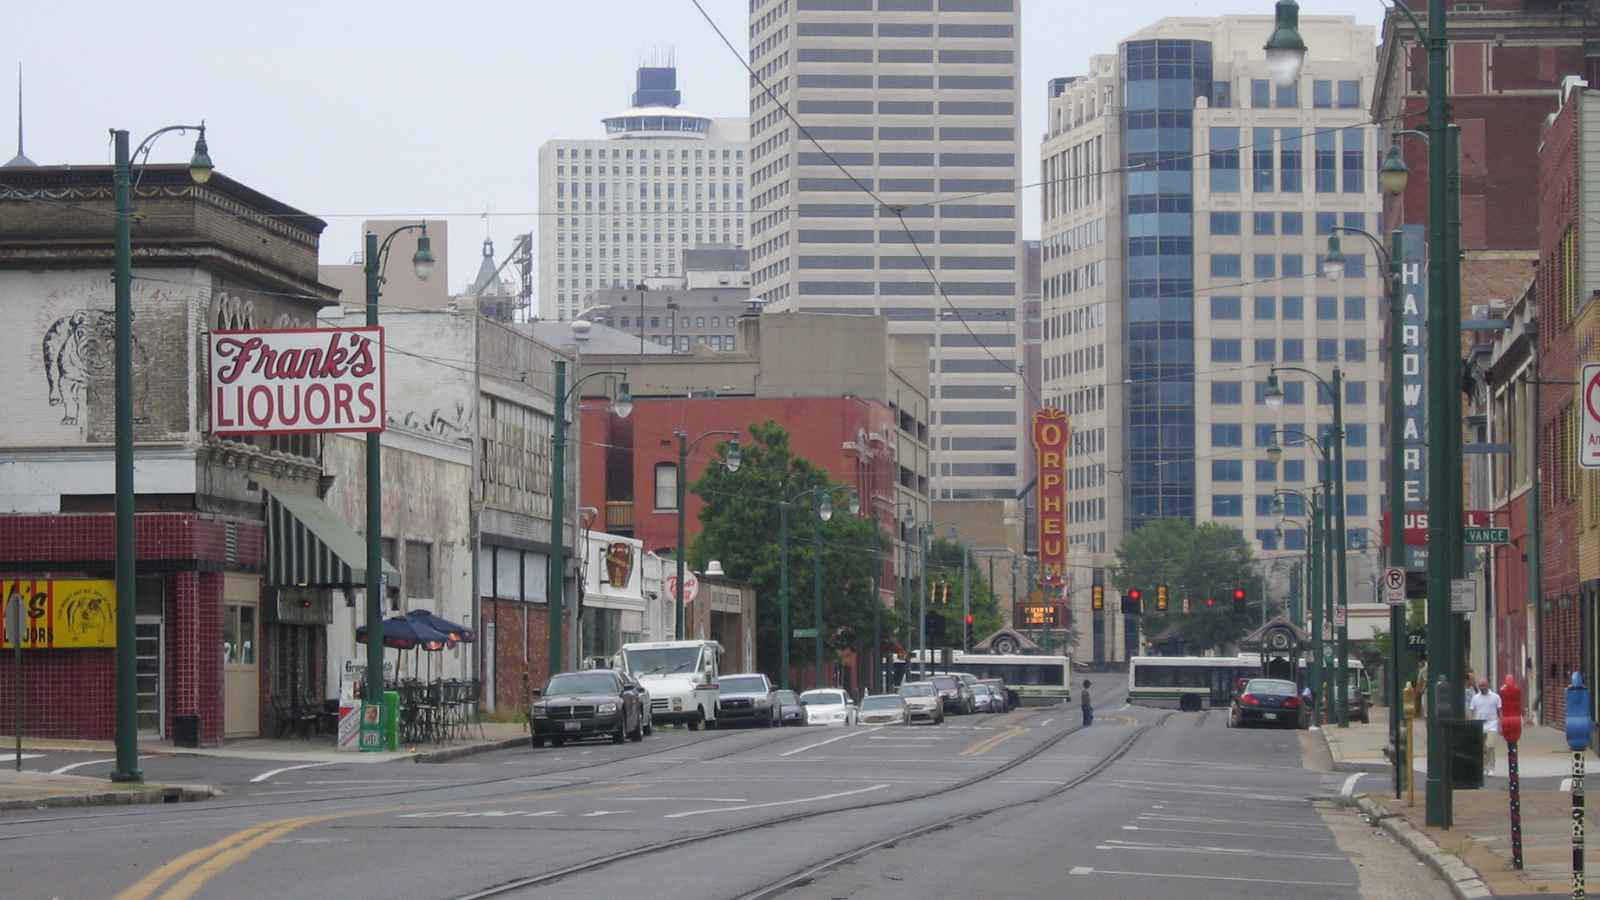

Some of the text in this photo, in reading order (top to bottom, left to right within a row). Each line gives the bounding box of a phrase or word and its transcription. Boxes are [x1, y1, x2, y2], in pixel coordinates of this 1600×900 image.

[216, 333, 376, 385] Frank's
[1401, 263, 1421, 502] HARDWARE
[216, 382, 376, 430] LIQUORS
[1469, 530, 1505, 542] VANCE
